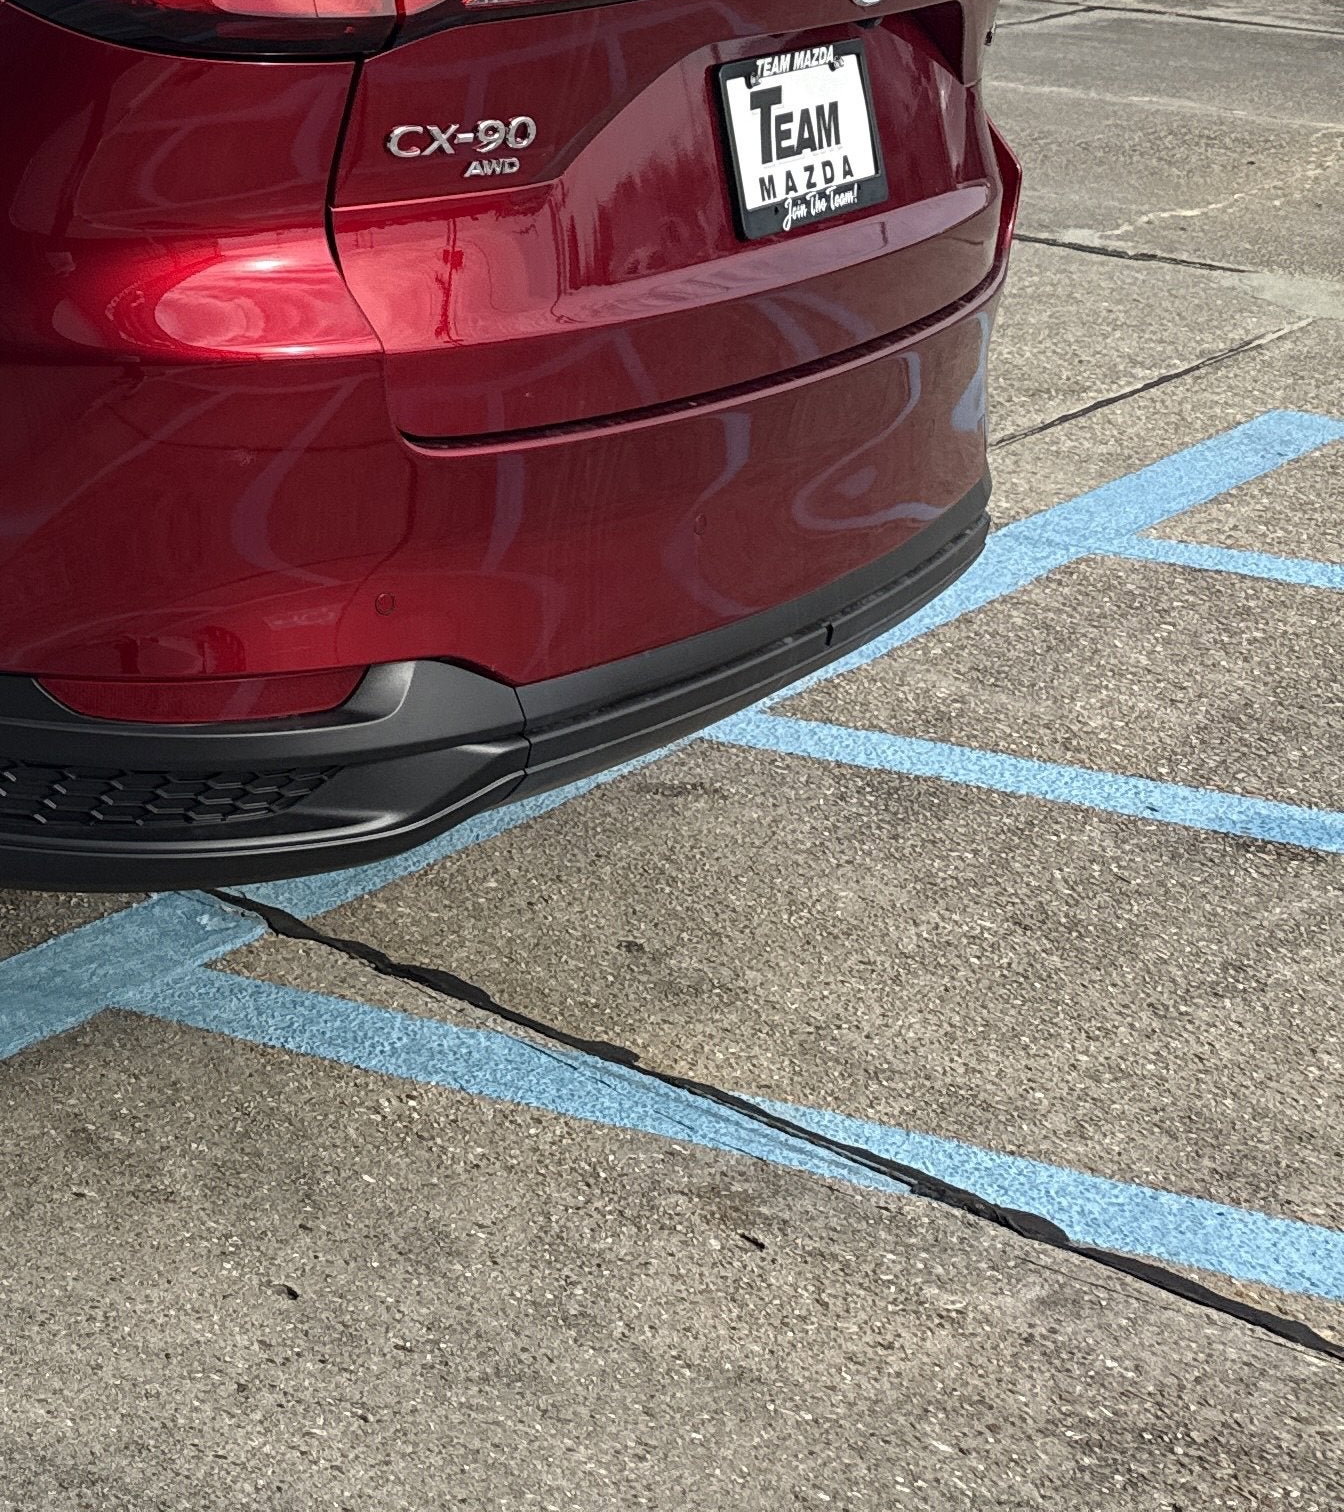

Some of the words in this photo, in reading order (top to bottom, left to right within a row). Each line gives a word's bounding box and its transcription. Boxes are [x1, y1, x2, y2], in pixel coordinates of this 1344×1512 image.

[756, 54, 791, 78] TEAM
[793, 45, 834, 71] MAZDA
[386, 115, 537, 158] CX-90
[750, 85, 841, 165] TEAM
[464, 157, 520, 178] AWD
[758, 155, 854, 201] MAZDA
[782, 191, 808, 231] Join
[805, 191, 827, 216] The
[826, 183, 858, 211] Team!
